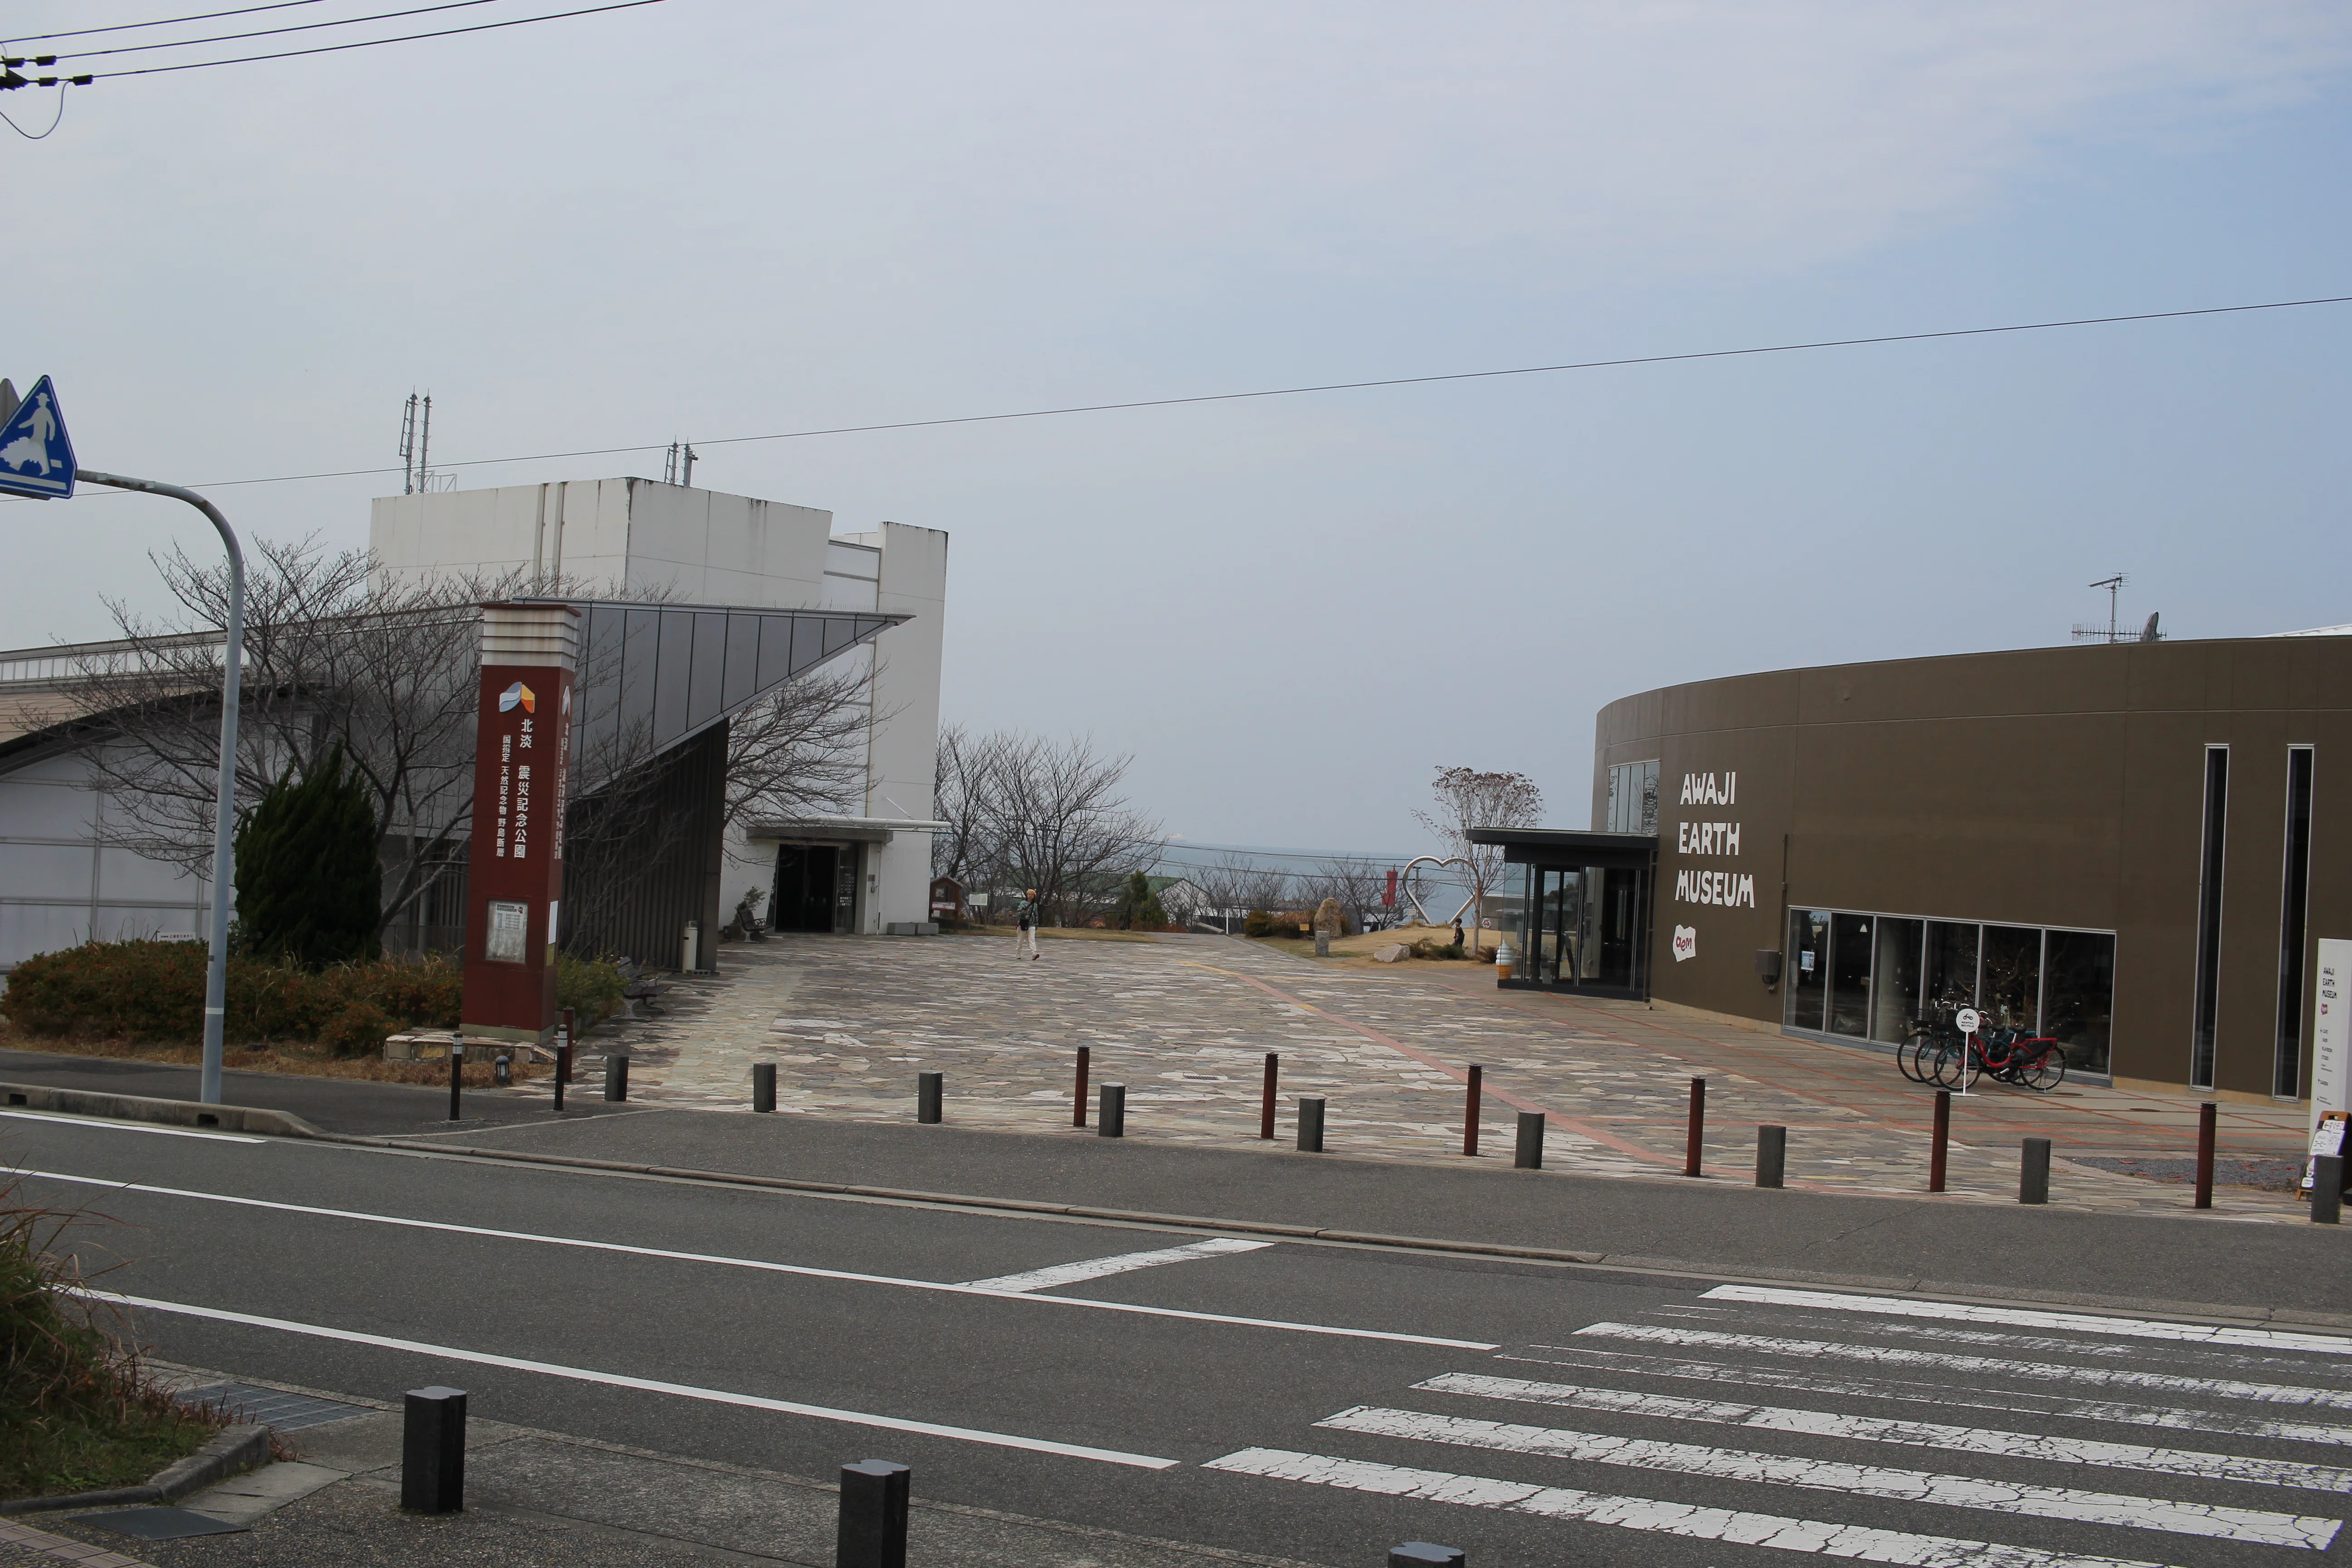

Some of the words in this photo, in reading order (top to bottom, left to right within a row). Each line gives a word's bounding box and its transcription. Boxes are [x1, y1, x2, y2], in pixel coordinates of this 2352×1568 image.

[501, 735, 511, 762] 国指定
[520, 719, 533, 749] 北淡
[499, 766, 510, 815] 天然記念物
[1680, 771, 1736, 805] AWAJI
[514, 765, 530, 858] 震災記念公園
[496, 818, 506, 857] 野島断層
[1679, 822, 1740, 856] EARTH
[1675, 870, 1755, 908] MUSEUM
[1676, 936, 1692, 951] aem
[2323, 967, 2334, 975] AWAJI
[2323, 978, 2335, 987] EARTH
[2322, 990, 2337, 1000] MUSEUM
